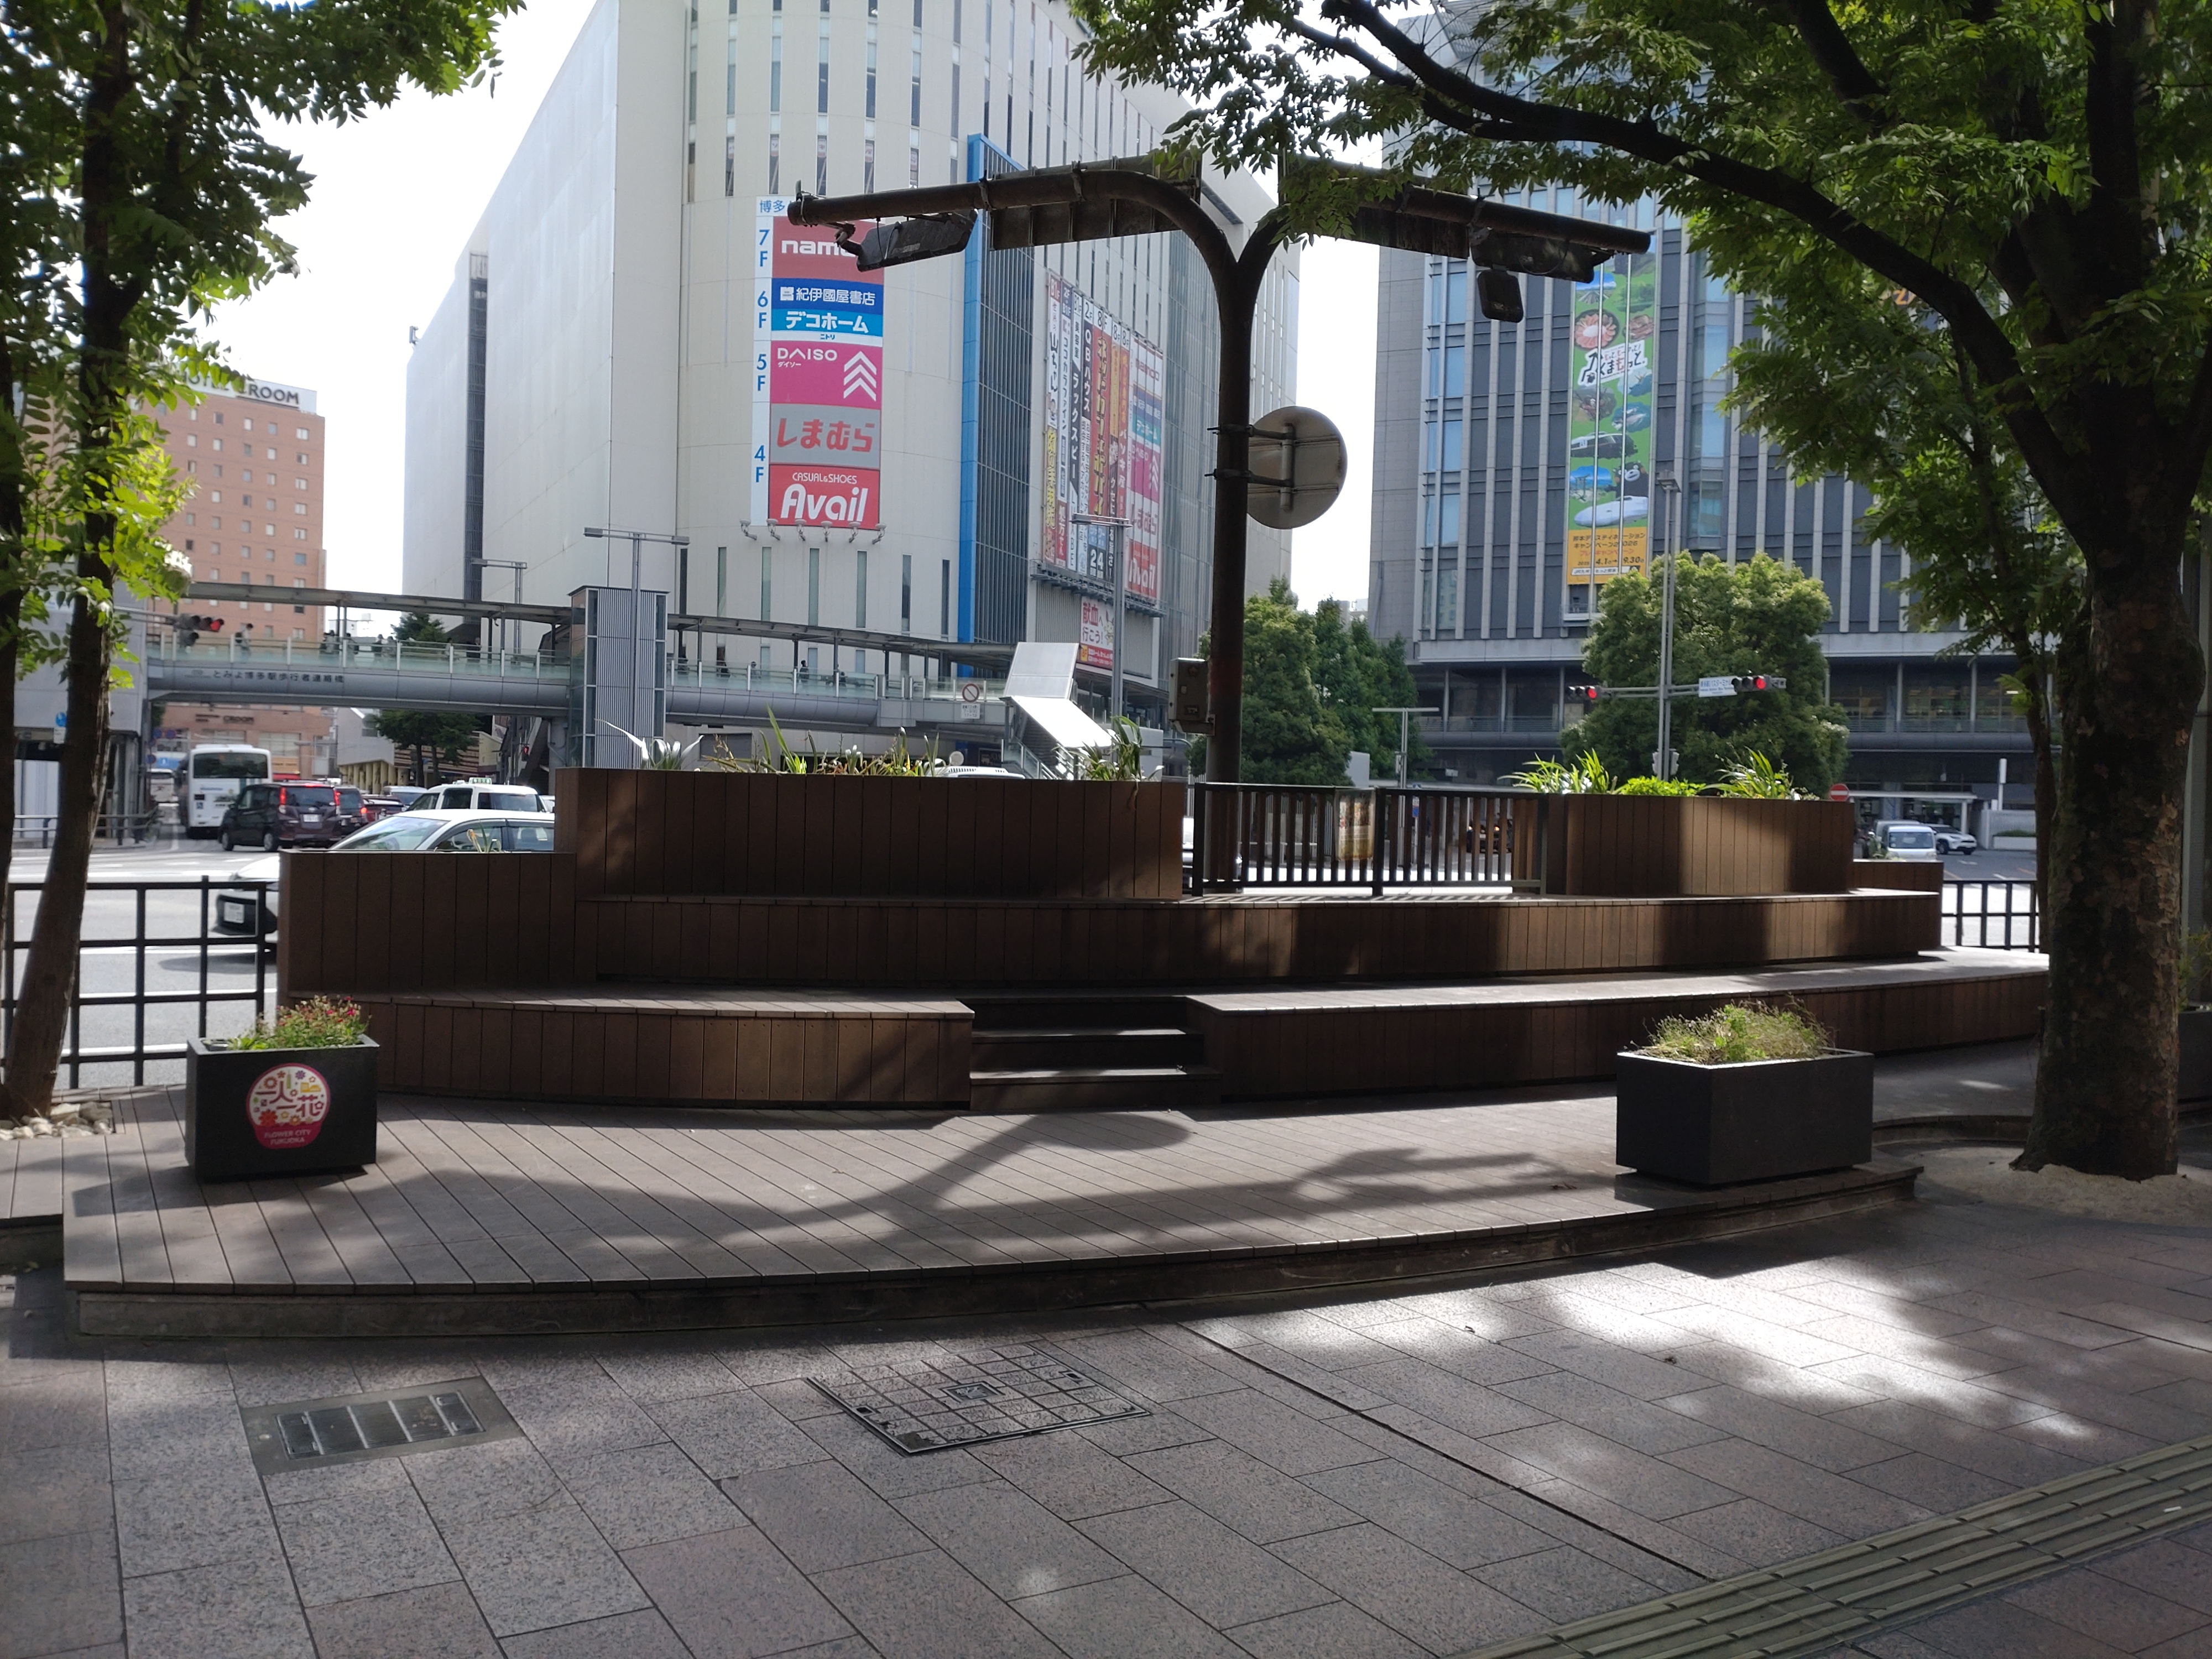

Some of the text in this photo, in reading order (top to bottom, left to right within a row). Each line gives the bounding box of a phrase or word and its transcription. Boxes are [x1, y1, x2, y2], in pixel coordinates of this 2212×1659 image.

[781, 240, 855, 257] nam
[796, 287, 875, 305] 紀伊國屋書店
[1085, 301, 1093, 320] 2F
[786, 311, 869, 333] デコホーム
[777, 347, 838, 361] DAISO
[239, 383, 299, 404] ROOM
[776, 418, 875, 453] しまむら
[780, 483, 869, 521] Avail
[1083, 601, 1103, 627] 献血へ
